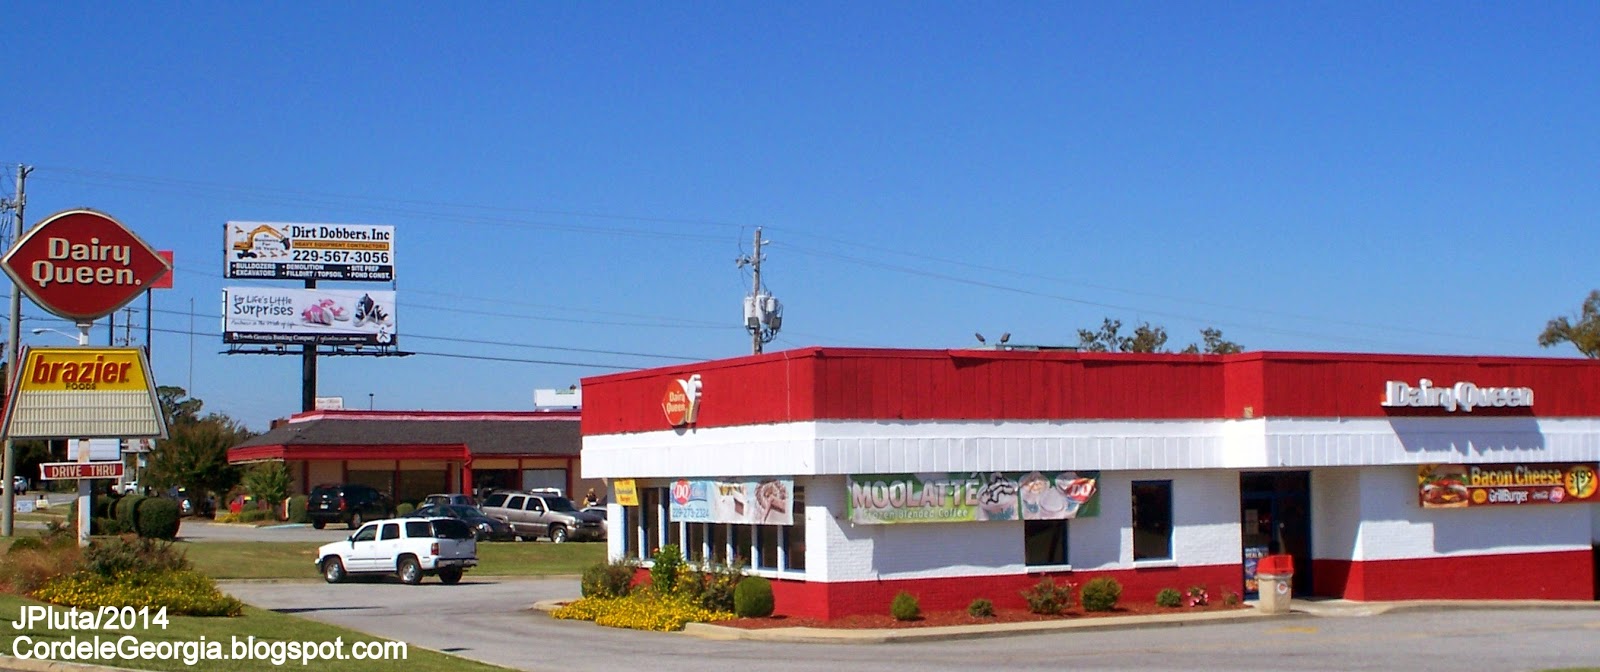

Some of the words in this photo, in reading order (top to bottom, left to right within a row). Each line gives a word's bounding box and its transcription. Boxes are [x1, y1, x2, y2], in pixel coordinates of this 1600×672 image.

[292, 226, 317, 238] Dirt
[48, 237, 131, 266] Dairy
[293, 250, 389, 263] 229-567-3056
[247, 295, 268, 304] Life's
[270, 296, 292, 305] Little
[234, 303, 294, 318] Surprises
[31, 354, 132, 384] brazier
[65, 382, 96, 390] FOODS
[1381, 378, 1456, 412] Dairy
[1454, 381, 1534, 412] Queen
[51, 465, 82, 478] DRIVE
[90, 464, 116, 476] THRU
[1471, 466, 1513, 486] Bacon
[1515, 465, 1562, 486] Cheese
[676, 484, 689, 498] DQ
[1071, 484, 1092, 496] DQ
[899, 508, 935, 519] Blended
[939, 507, 968, 518] Coffee
